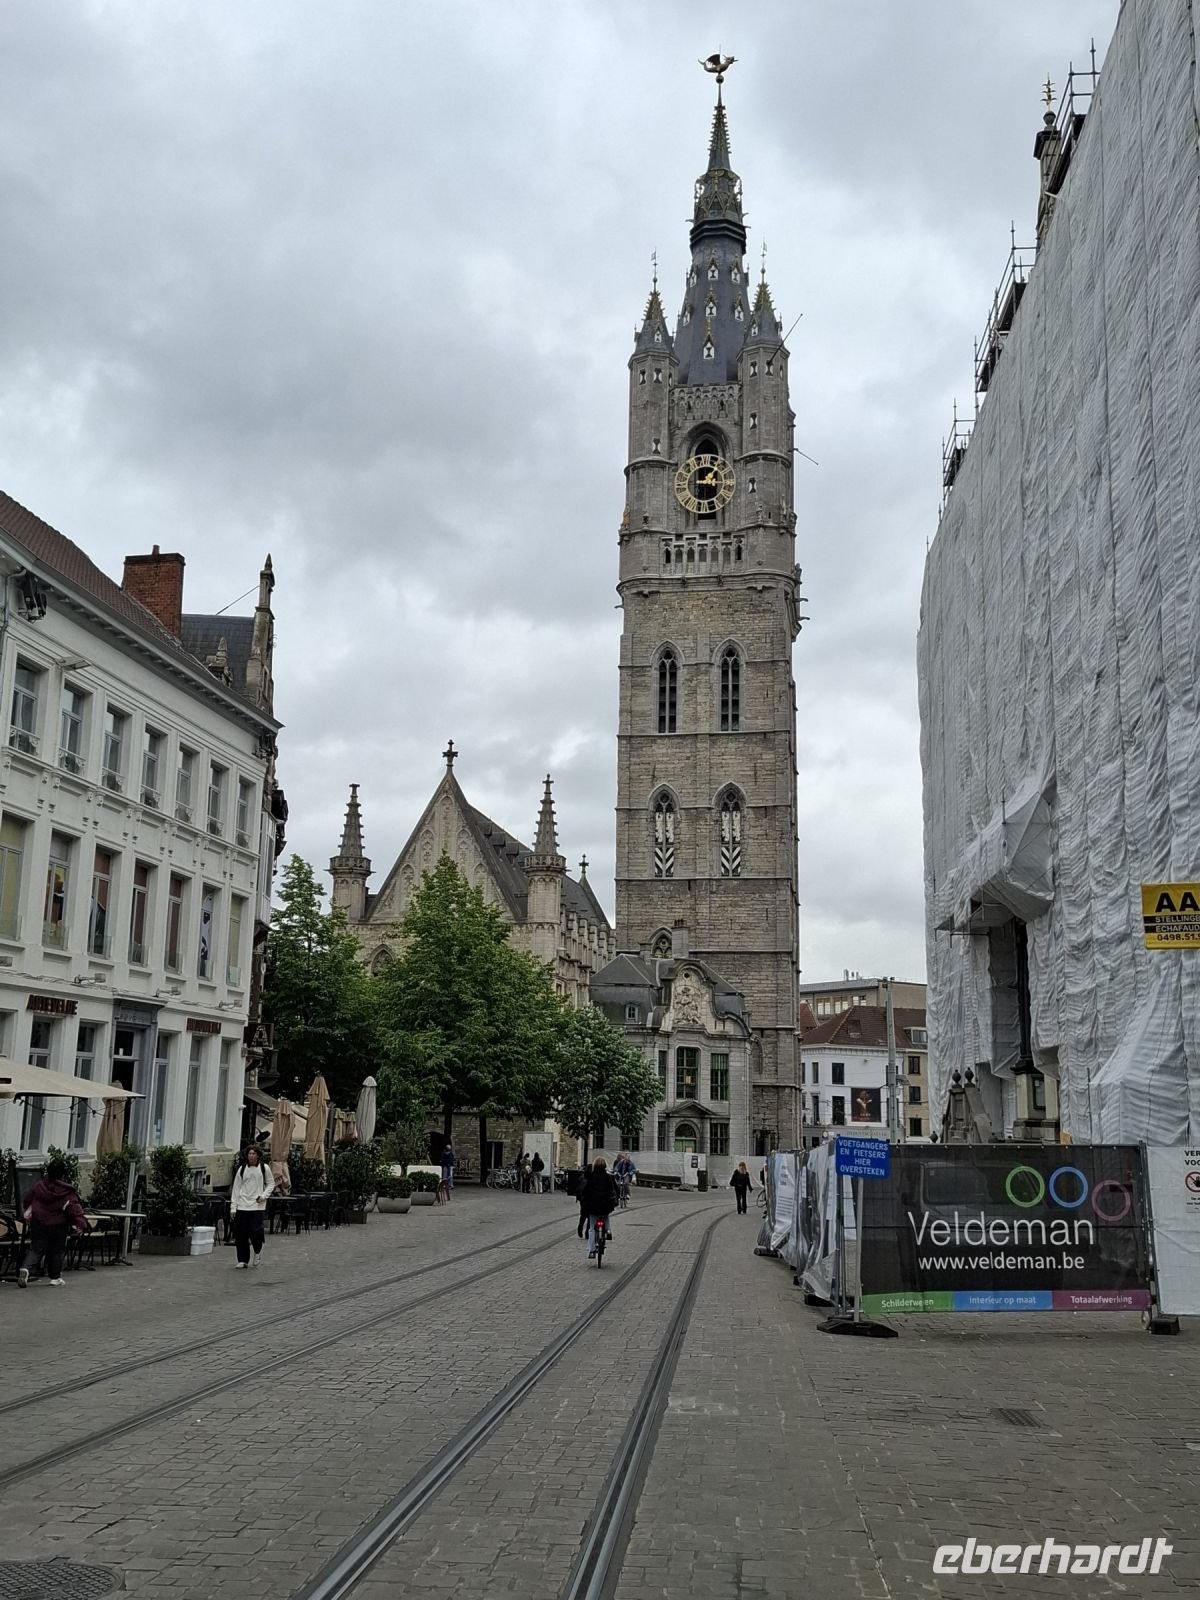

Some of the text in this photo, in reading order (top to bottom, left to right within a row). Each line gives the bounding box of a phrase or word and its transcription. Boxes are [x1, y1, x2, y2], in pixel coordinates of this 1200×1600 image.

[838, 1139, 888, 1151] VOETGANGERS
[853, 1149, 886, 1159] FIETSERS
[854, 1158, 871, 1166] HIER
[840, 1166, 885, 1176] OVERSTEKEN
[907, 1211, 1094, 1246] Veldeman
[918, 1252, 1085, 1270] www.veldeman.be
[969, 1295, 1036, 1305] Interieur op maat
[1070, 1295, 1133, 1305] Totaalafwerking
